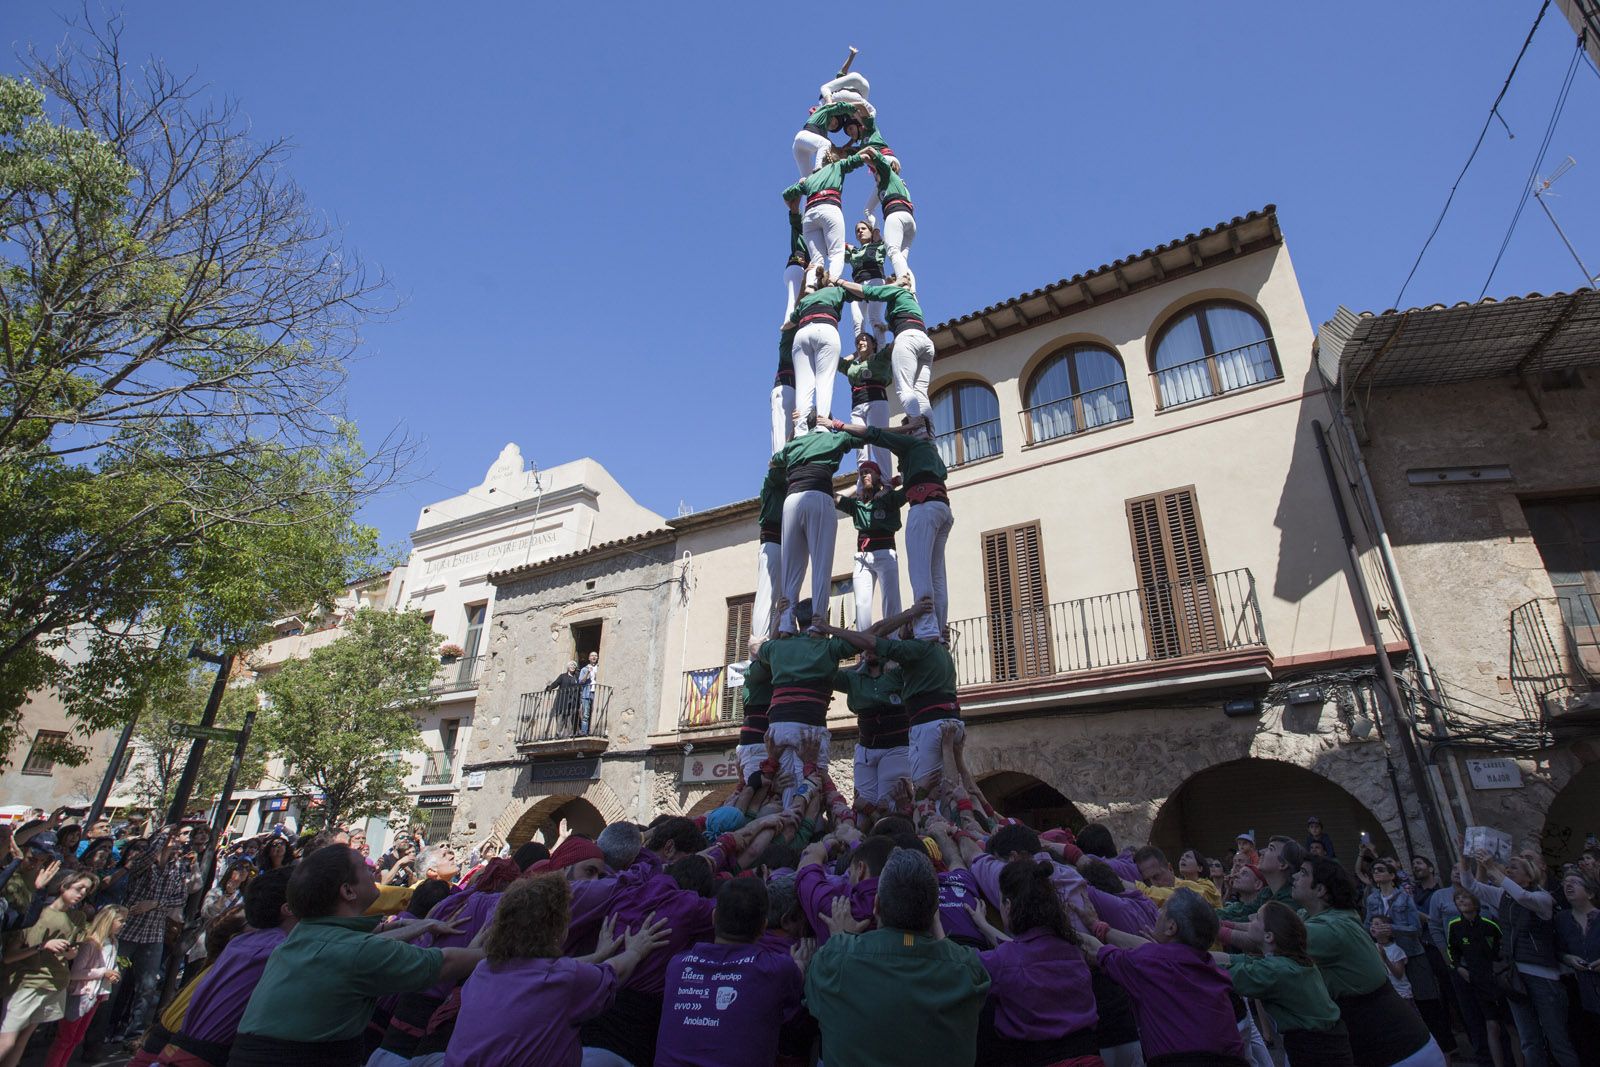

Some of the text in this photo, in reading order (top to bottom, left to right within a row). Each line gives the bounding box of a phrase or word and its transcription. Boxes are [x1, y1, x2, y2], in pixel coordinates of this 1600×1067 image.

[452, 552, 480, 567] ESTEVE
[488, 543, 517, 557] CENTRE
[530, 532, 557, 546] DANSA
[1487, 774, 1511, 783] MAJOR
